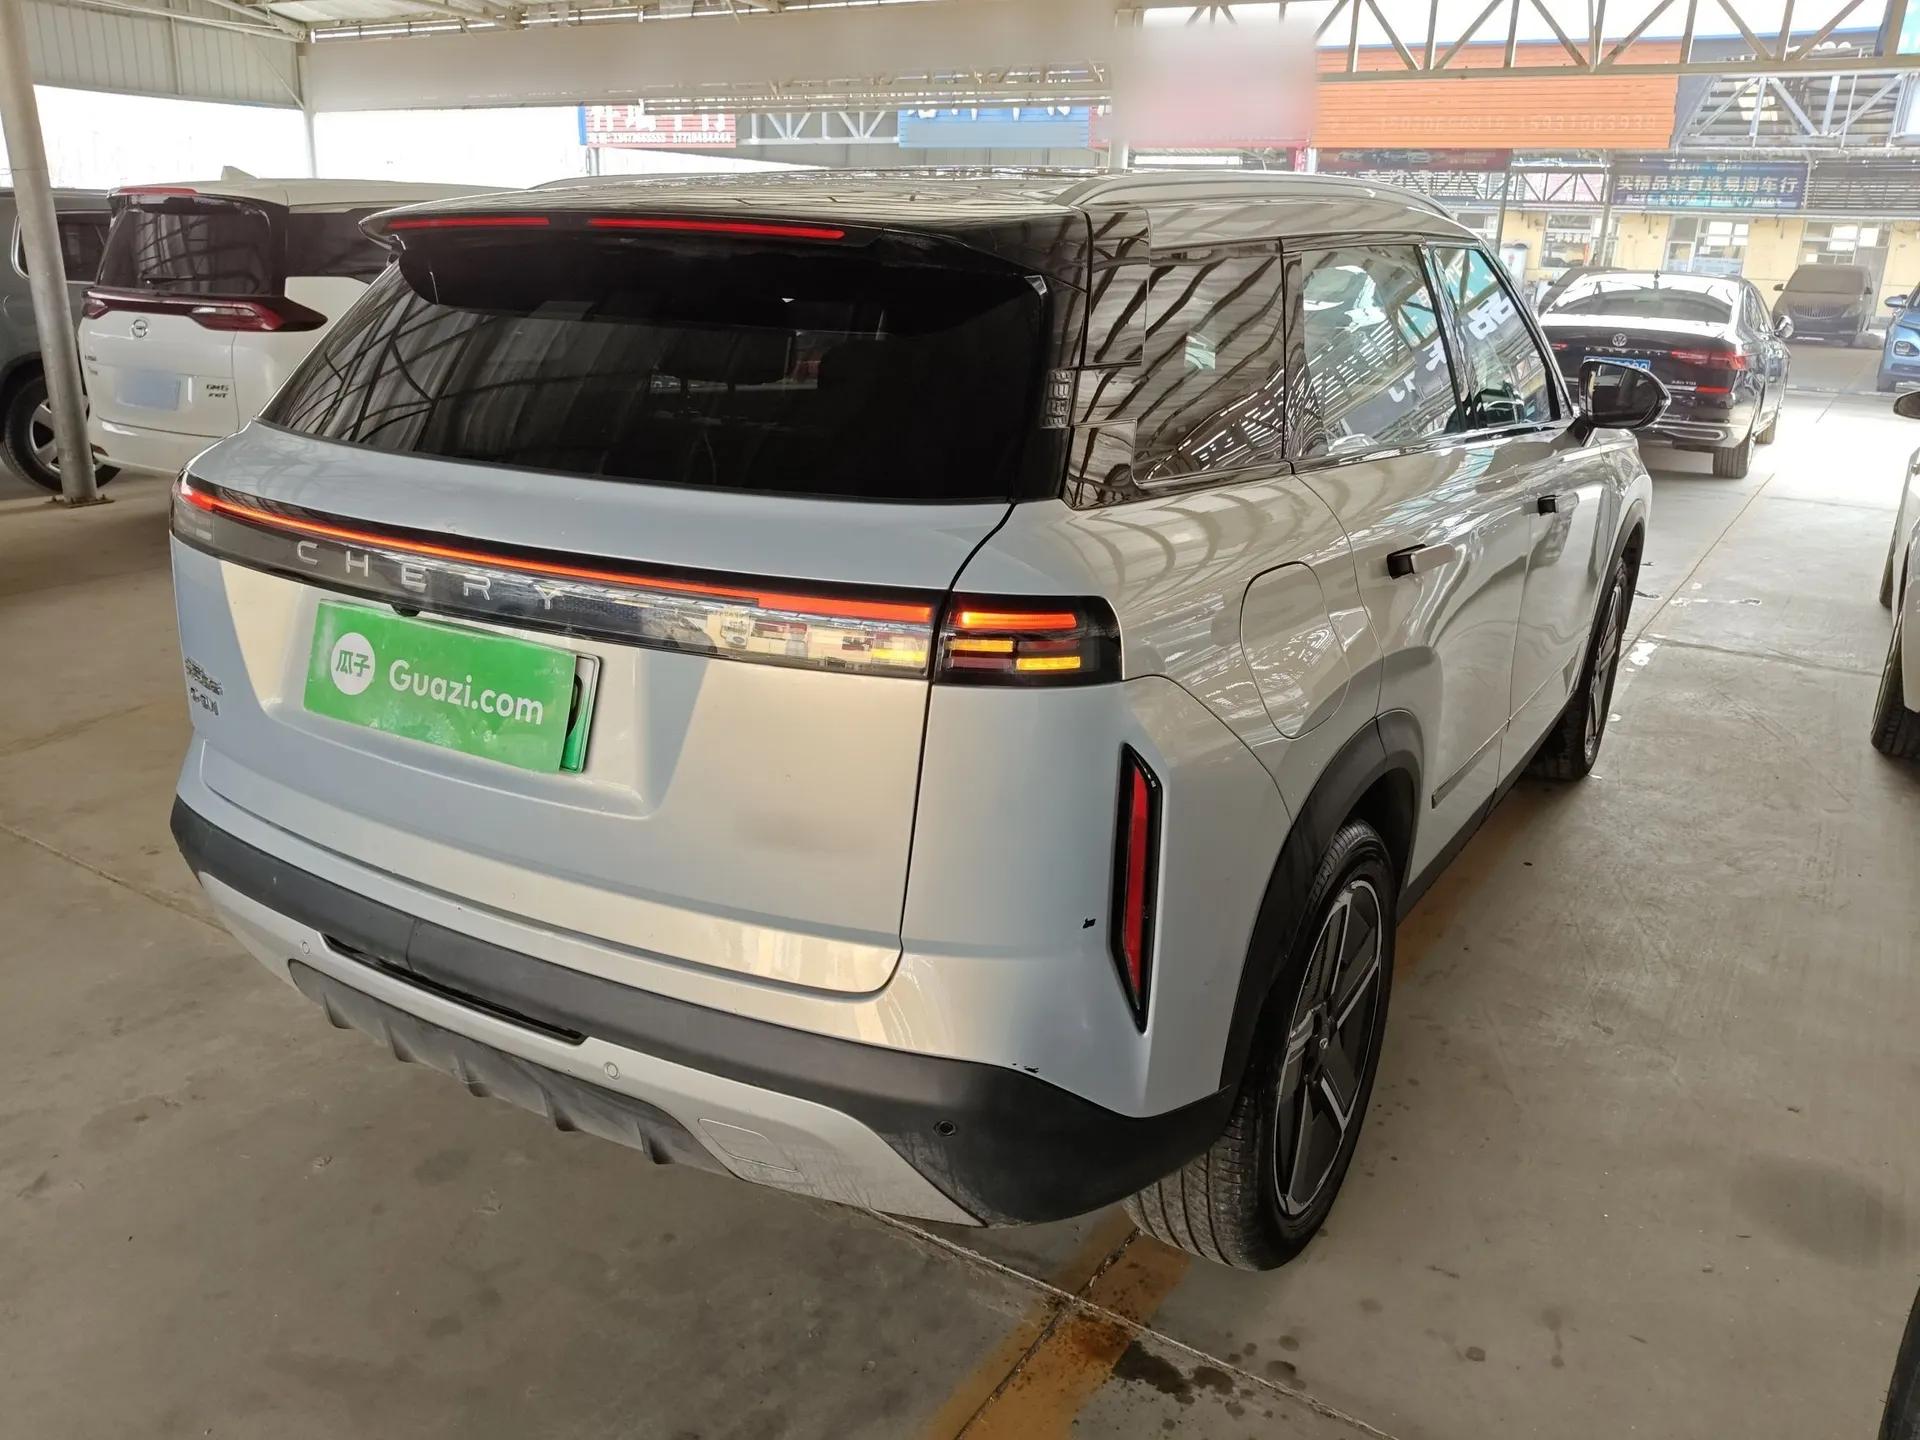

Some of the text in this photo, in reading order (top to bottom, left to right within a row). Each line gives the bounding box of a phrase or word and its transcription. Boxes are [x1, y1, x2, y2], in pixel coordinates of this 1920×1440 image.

[296, 540, 561, 611] CHERY
[335, 649, 370, 677] 瓜子
[388, 659, 543, 725] Guazi.com
